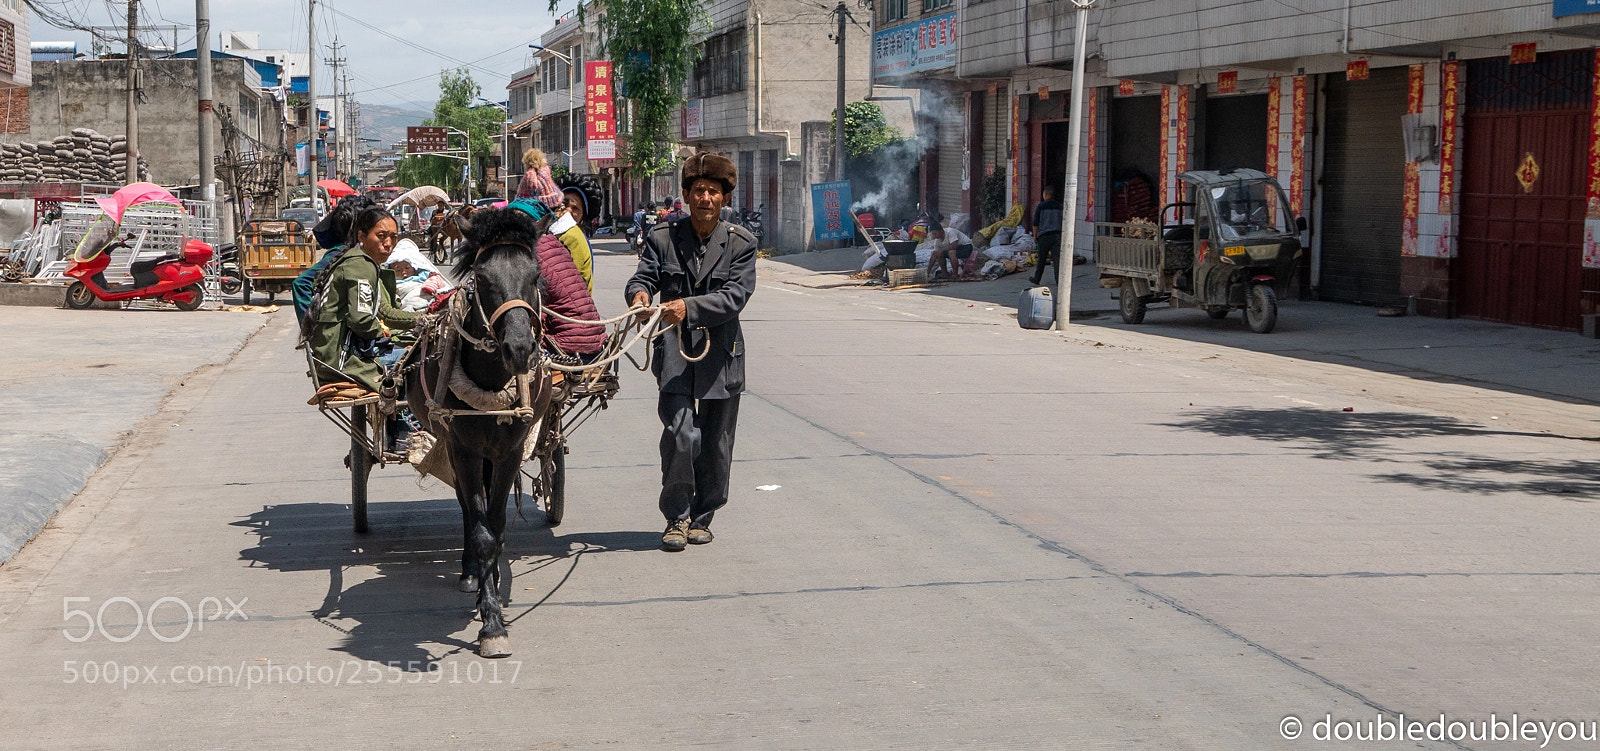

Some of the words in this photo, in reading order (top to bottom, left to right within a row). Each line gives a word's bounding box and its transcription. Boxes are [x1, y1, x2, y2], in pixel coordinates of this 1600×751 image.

[918, 15, 957, 51] 航越驾校
[595, 66, 607, 133] 清泉宾馆
[823, 189, 842, 231] 航越驾校
